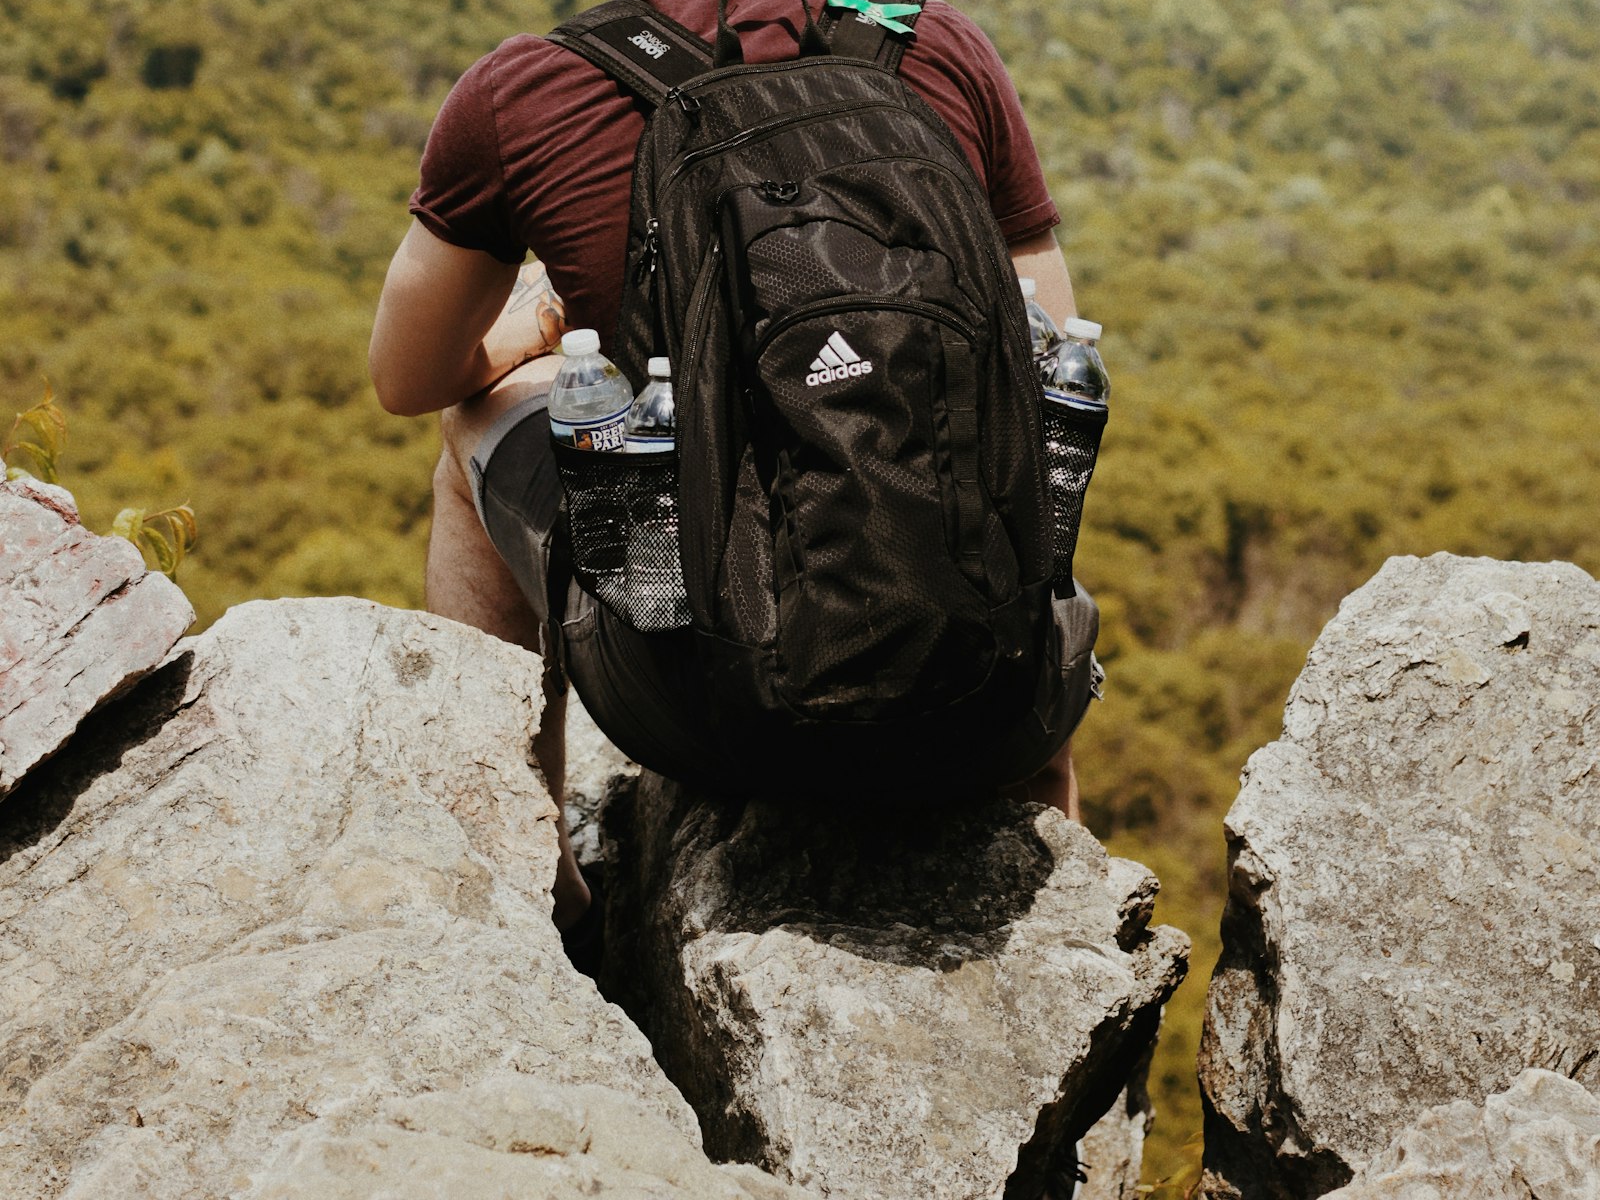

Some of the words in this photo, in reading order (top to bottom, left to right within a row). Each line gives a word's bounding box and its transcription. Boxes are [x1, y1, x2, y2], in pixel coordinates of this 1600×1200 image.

[631, 35, 665, 59] LOAD
[640, 30, 670, 52] SPRING
[806, 361, 873, 387] adidas
[590, 422, 625, 442] DEER
